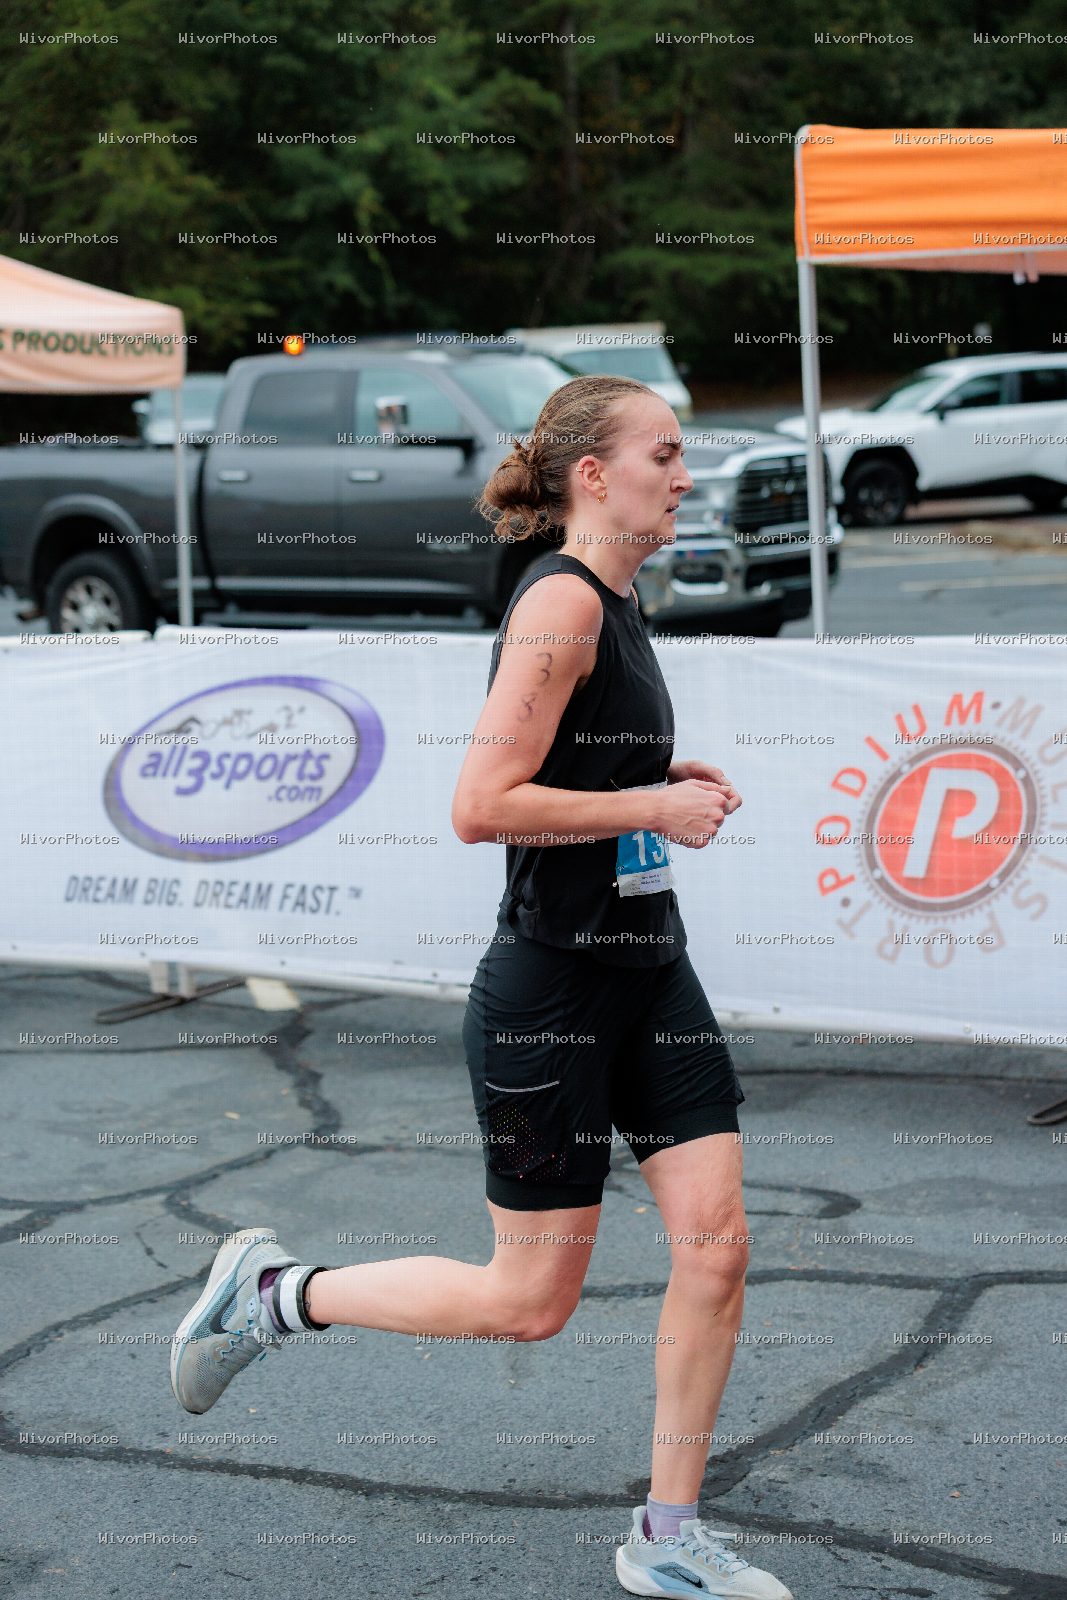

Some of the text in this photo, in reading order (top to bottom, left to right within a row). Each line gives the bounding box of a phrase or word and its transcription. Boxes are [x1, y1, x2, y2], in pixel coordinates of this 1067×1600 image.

[139, 745, 331, 796] all3sports
[267, 785, 322, 802] .com
[814, 690, 985, 897] PODIUM
[902, 766, 1001, 880] P
[632, 829, 670, 867] 13
[64, 875, 139, 904] DREAM
[143, 877, 184, 907] BIG.
[194, 879, 273, 911] DREAM
